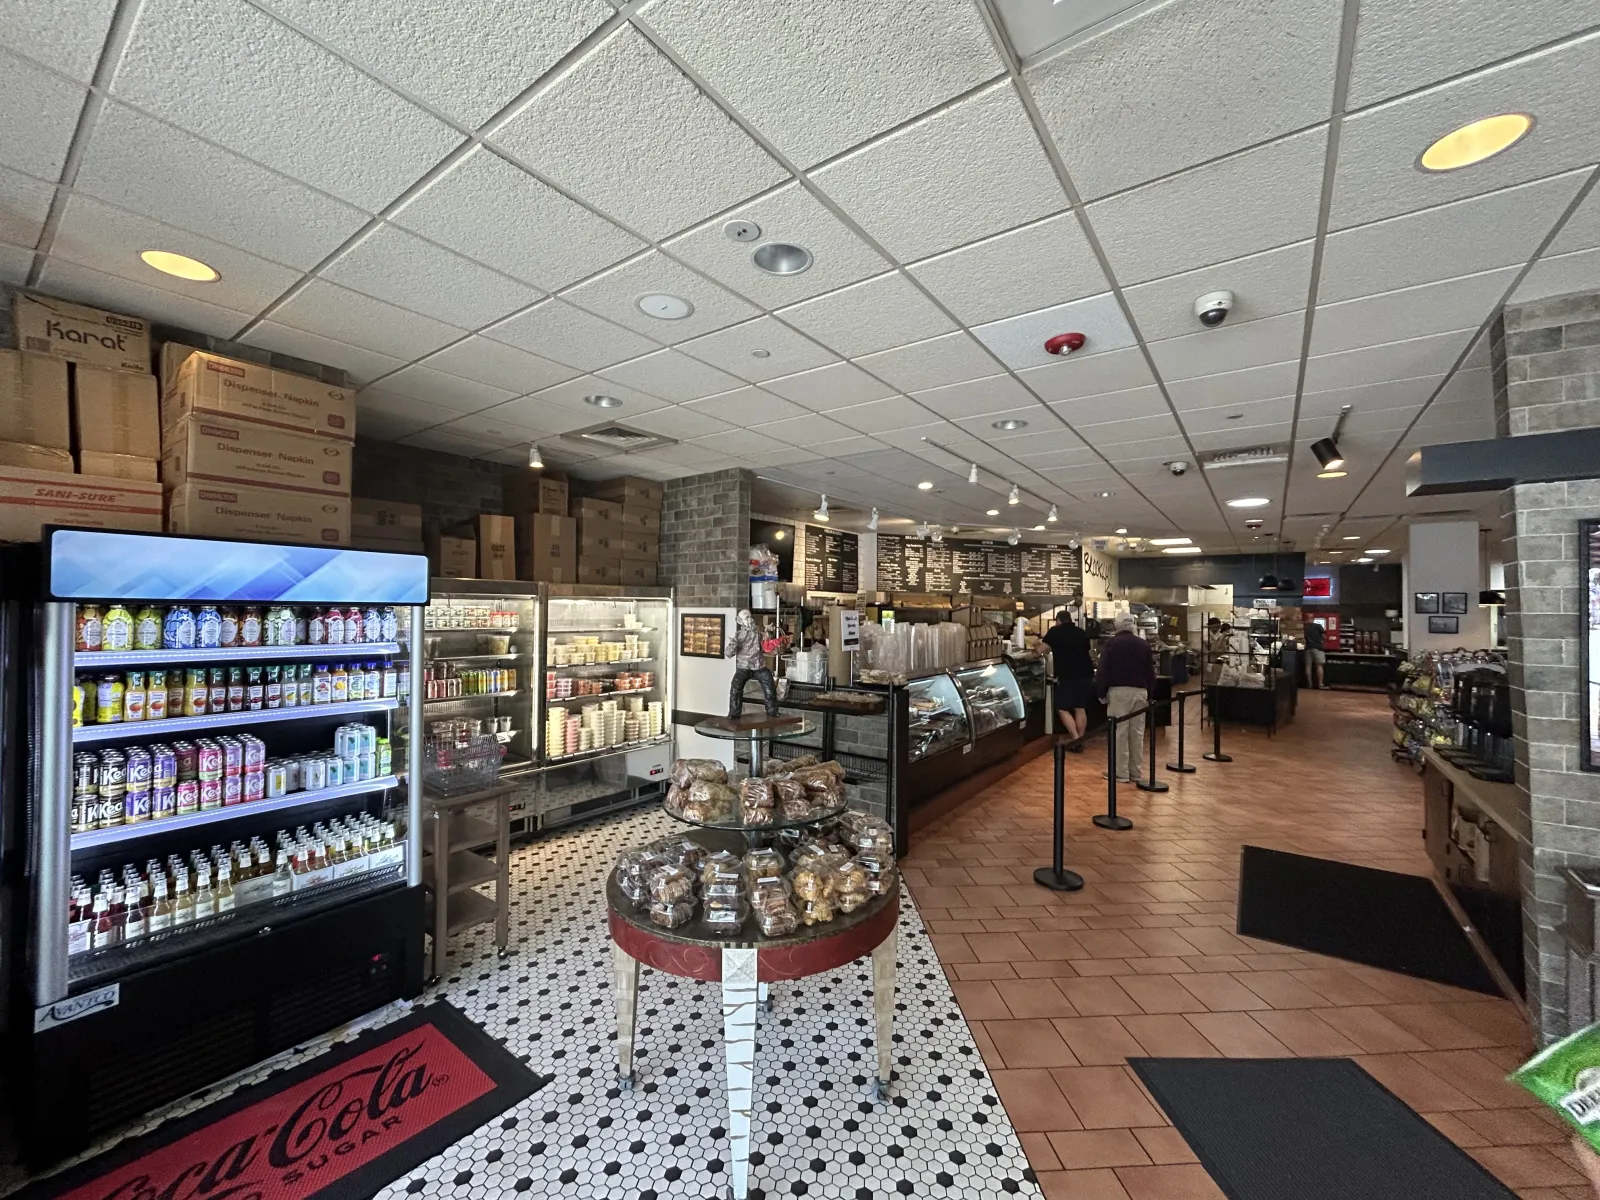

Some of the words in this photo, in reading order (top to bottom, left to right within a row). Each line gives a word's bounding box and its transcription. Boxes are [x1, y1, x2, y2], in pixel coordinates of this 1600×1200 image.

[46, 319, 126, 352] Karat
[223, 378, 279, 399] Dispenser
[283, 392, 320, 408] Napkin
[217, 442, 274, 459] Dispenser
[278, 451, 315, 466] Napkin
[35, 488, 118, 503] SANI-SURE
[215, 506, 271, 520] Dispenser
[276, 512, 313, 525] Napkin
[99, 801, 123, 819] Kea
[282, 1115, 404, 1185] SUGAR
